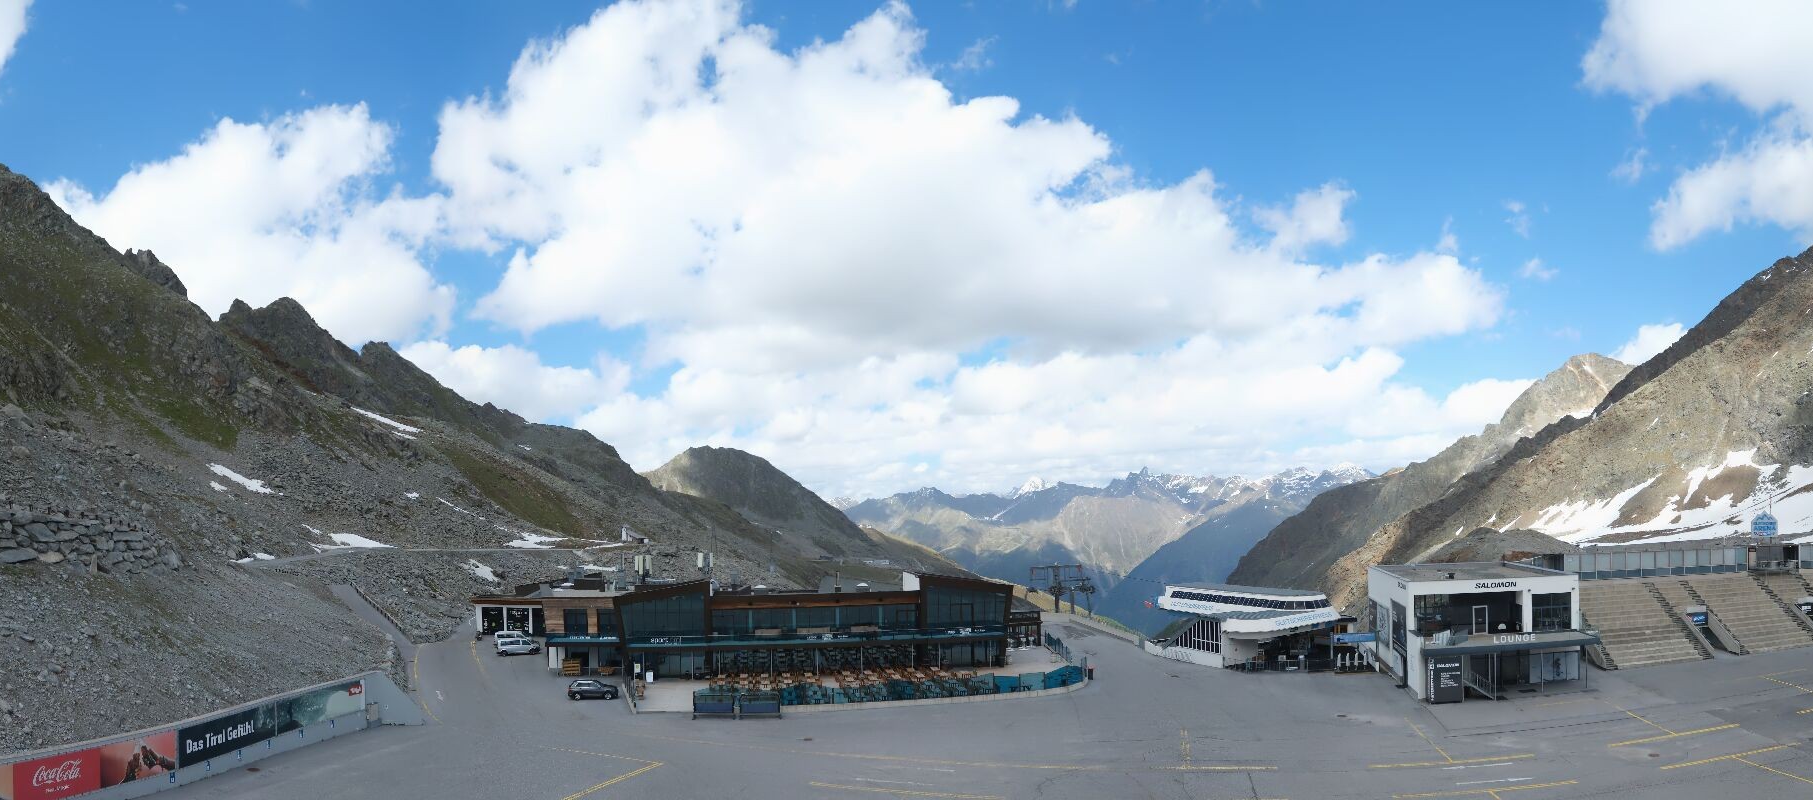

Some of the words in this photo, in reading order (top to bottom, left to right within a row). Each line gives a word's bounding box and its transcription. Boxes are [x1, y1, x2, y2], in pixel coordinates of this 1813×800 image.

[1474, 581, 1517, 589] SALOMON
[1493, 633, 1536, 644] LOUNGE
[186, 739, 204, 754] Das
[205, 728, 226, 748] Tirol
[228, 719, 255, 740] Gefühl
